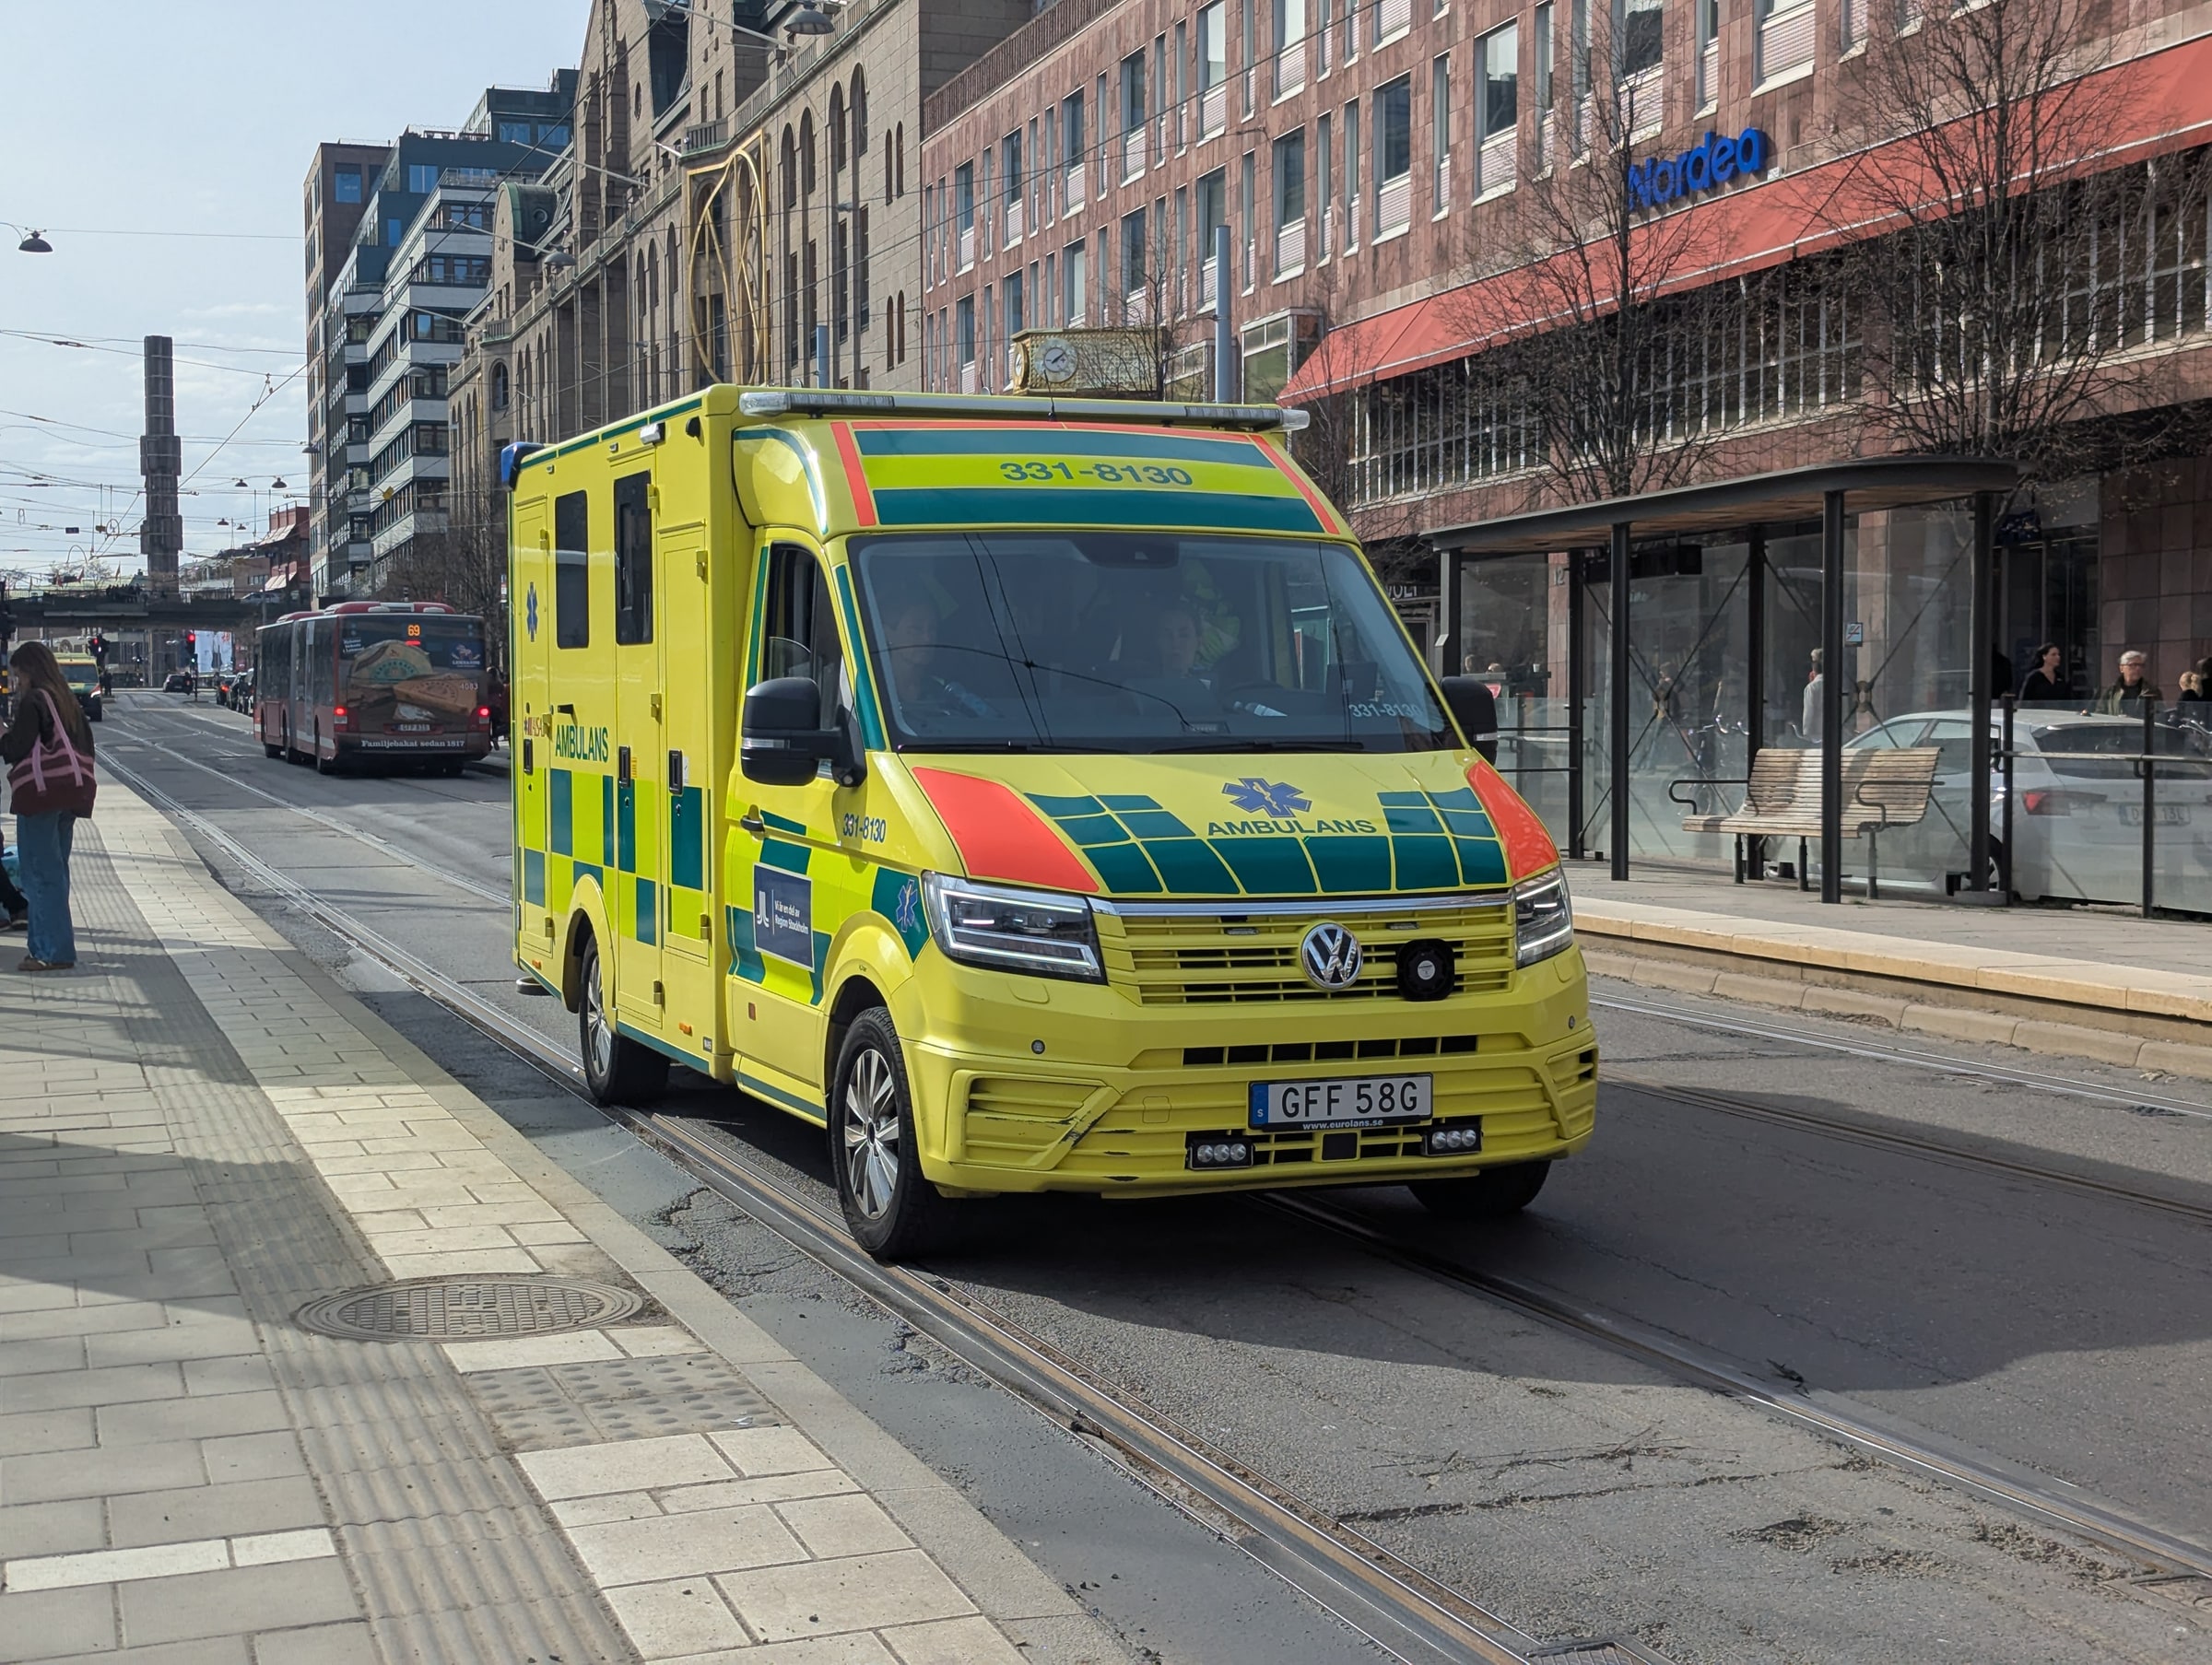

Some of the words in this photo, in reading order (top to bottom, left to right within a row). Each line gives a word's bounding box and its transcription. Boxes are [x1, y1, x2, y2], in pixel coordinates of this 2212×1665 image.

[1628, 127, 1765, 212] Nordea
[1000, 462, 1193, 486] 331-8130
[407, 625, 420, 637] 69
[1348, 703, 1425, 718] 331-8130
[361, 740, 418, 748] Familjebakat
[555, 724, 608, 763] AMBULANS
[843, 813, 886, 843] 331-8130
[1207, 819, 1377, 836] AMBULANS
[775, 914, 788, 929] Region
[788, 919, 809, 934] Stockholm
[1281, 1085, 1343, 1118] GFF
[1356, 1081, 1418, 1114] 58G
[1257, 1108, 1264, 1118] S
[1302, 1119, 1383, 1131] www.eurolans.se
